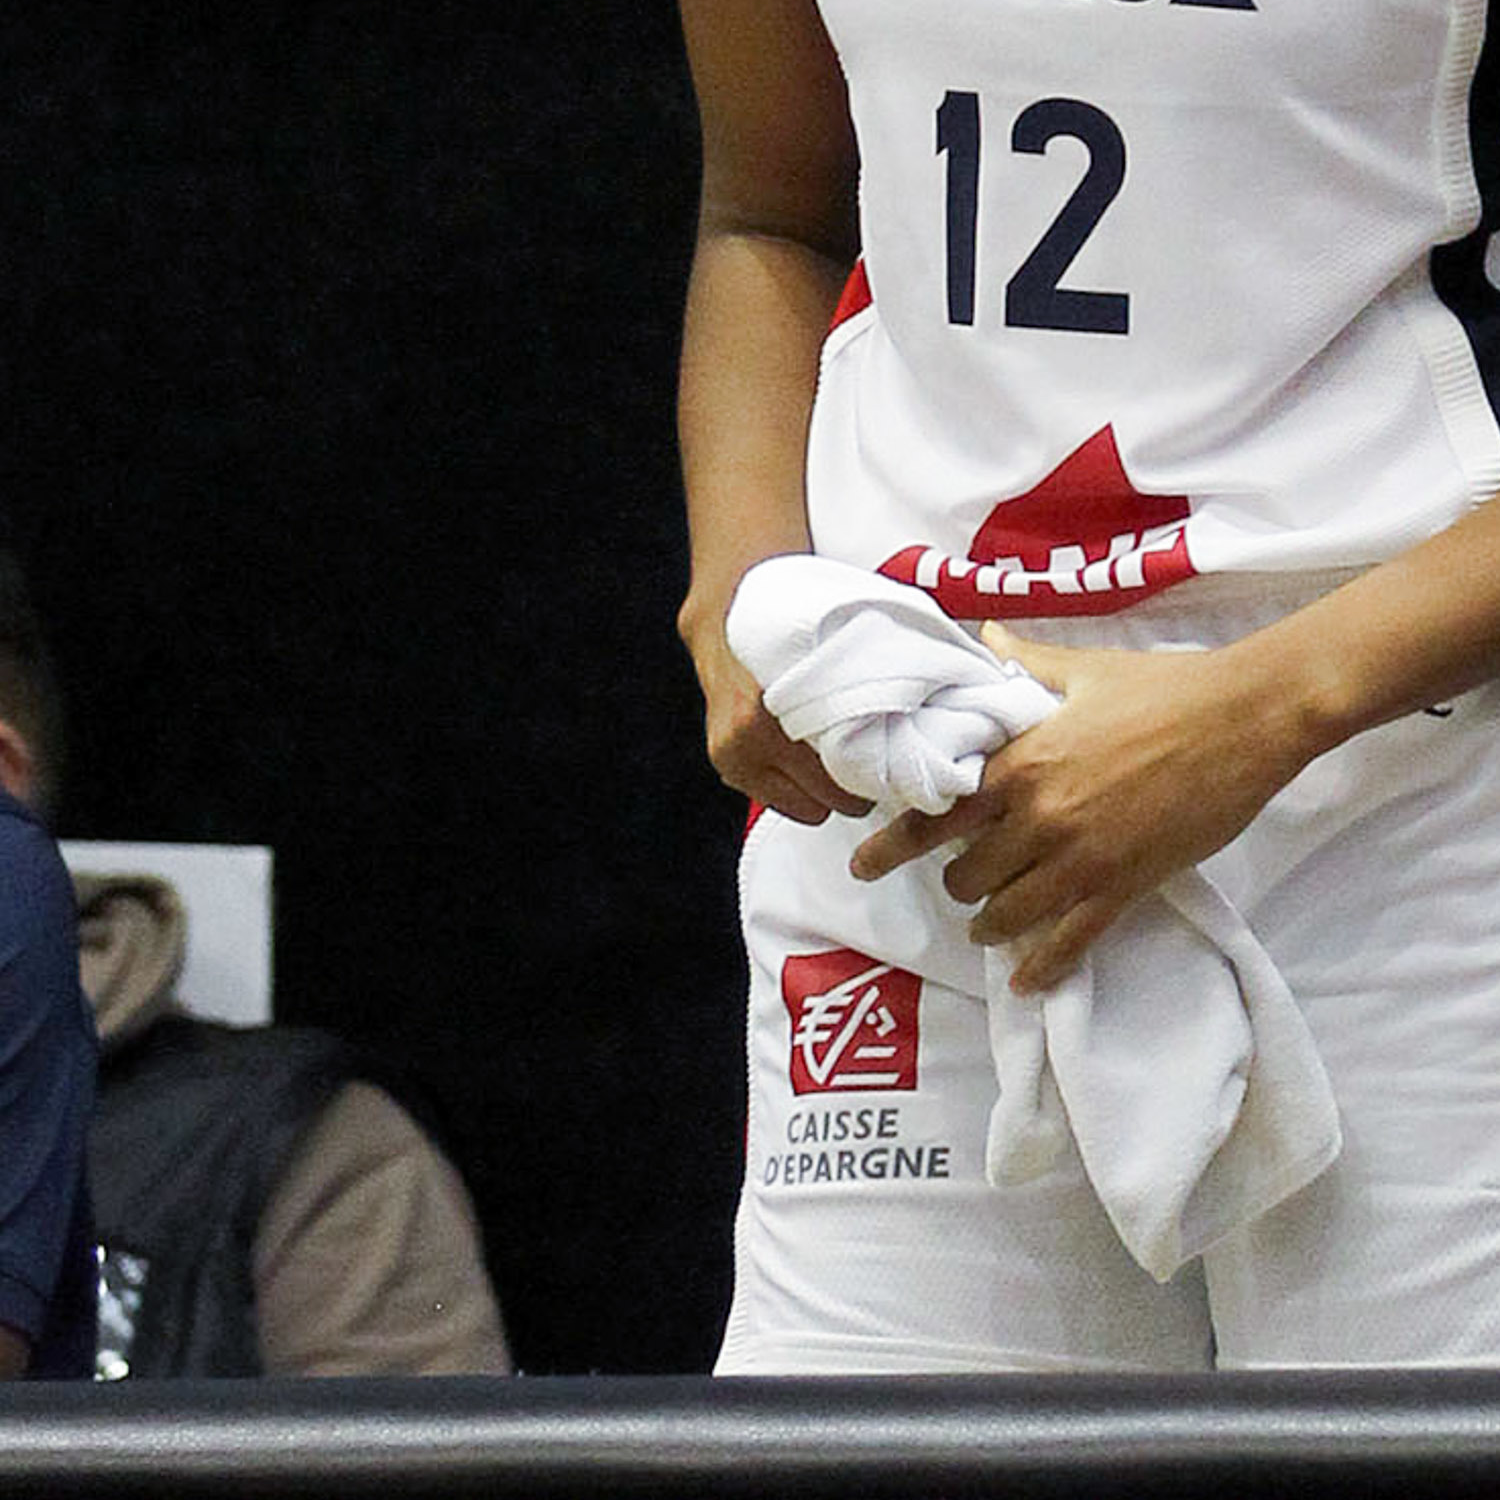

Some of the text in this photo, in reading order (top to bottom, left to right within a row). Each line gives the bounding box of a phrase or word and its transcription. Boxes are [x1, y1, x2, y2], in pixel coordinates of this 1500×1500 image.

[936, 90, 1130, 335] 12
[786, 1108, 901, 1144] CAISSE
[764, 1146, 951, 1187] D'EPARGNE
